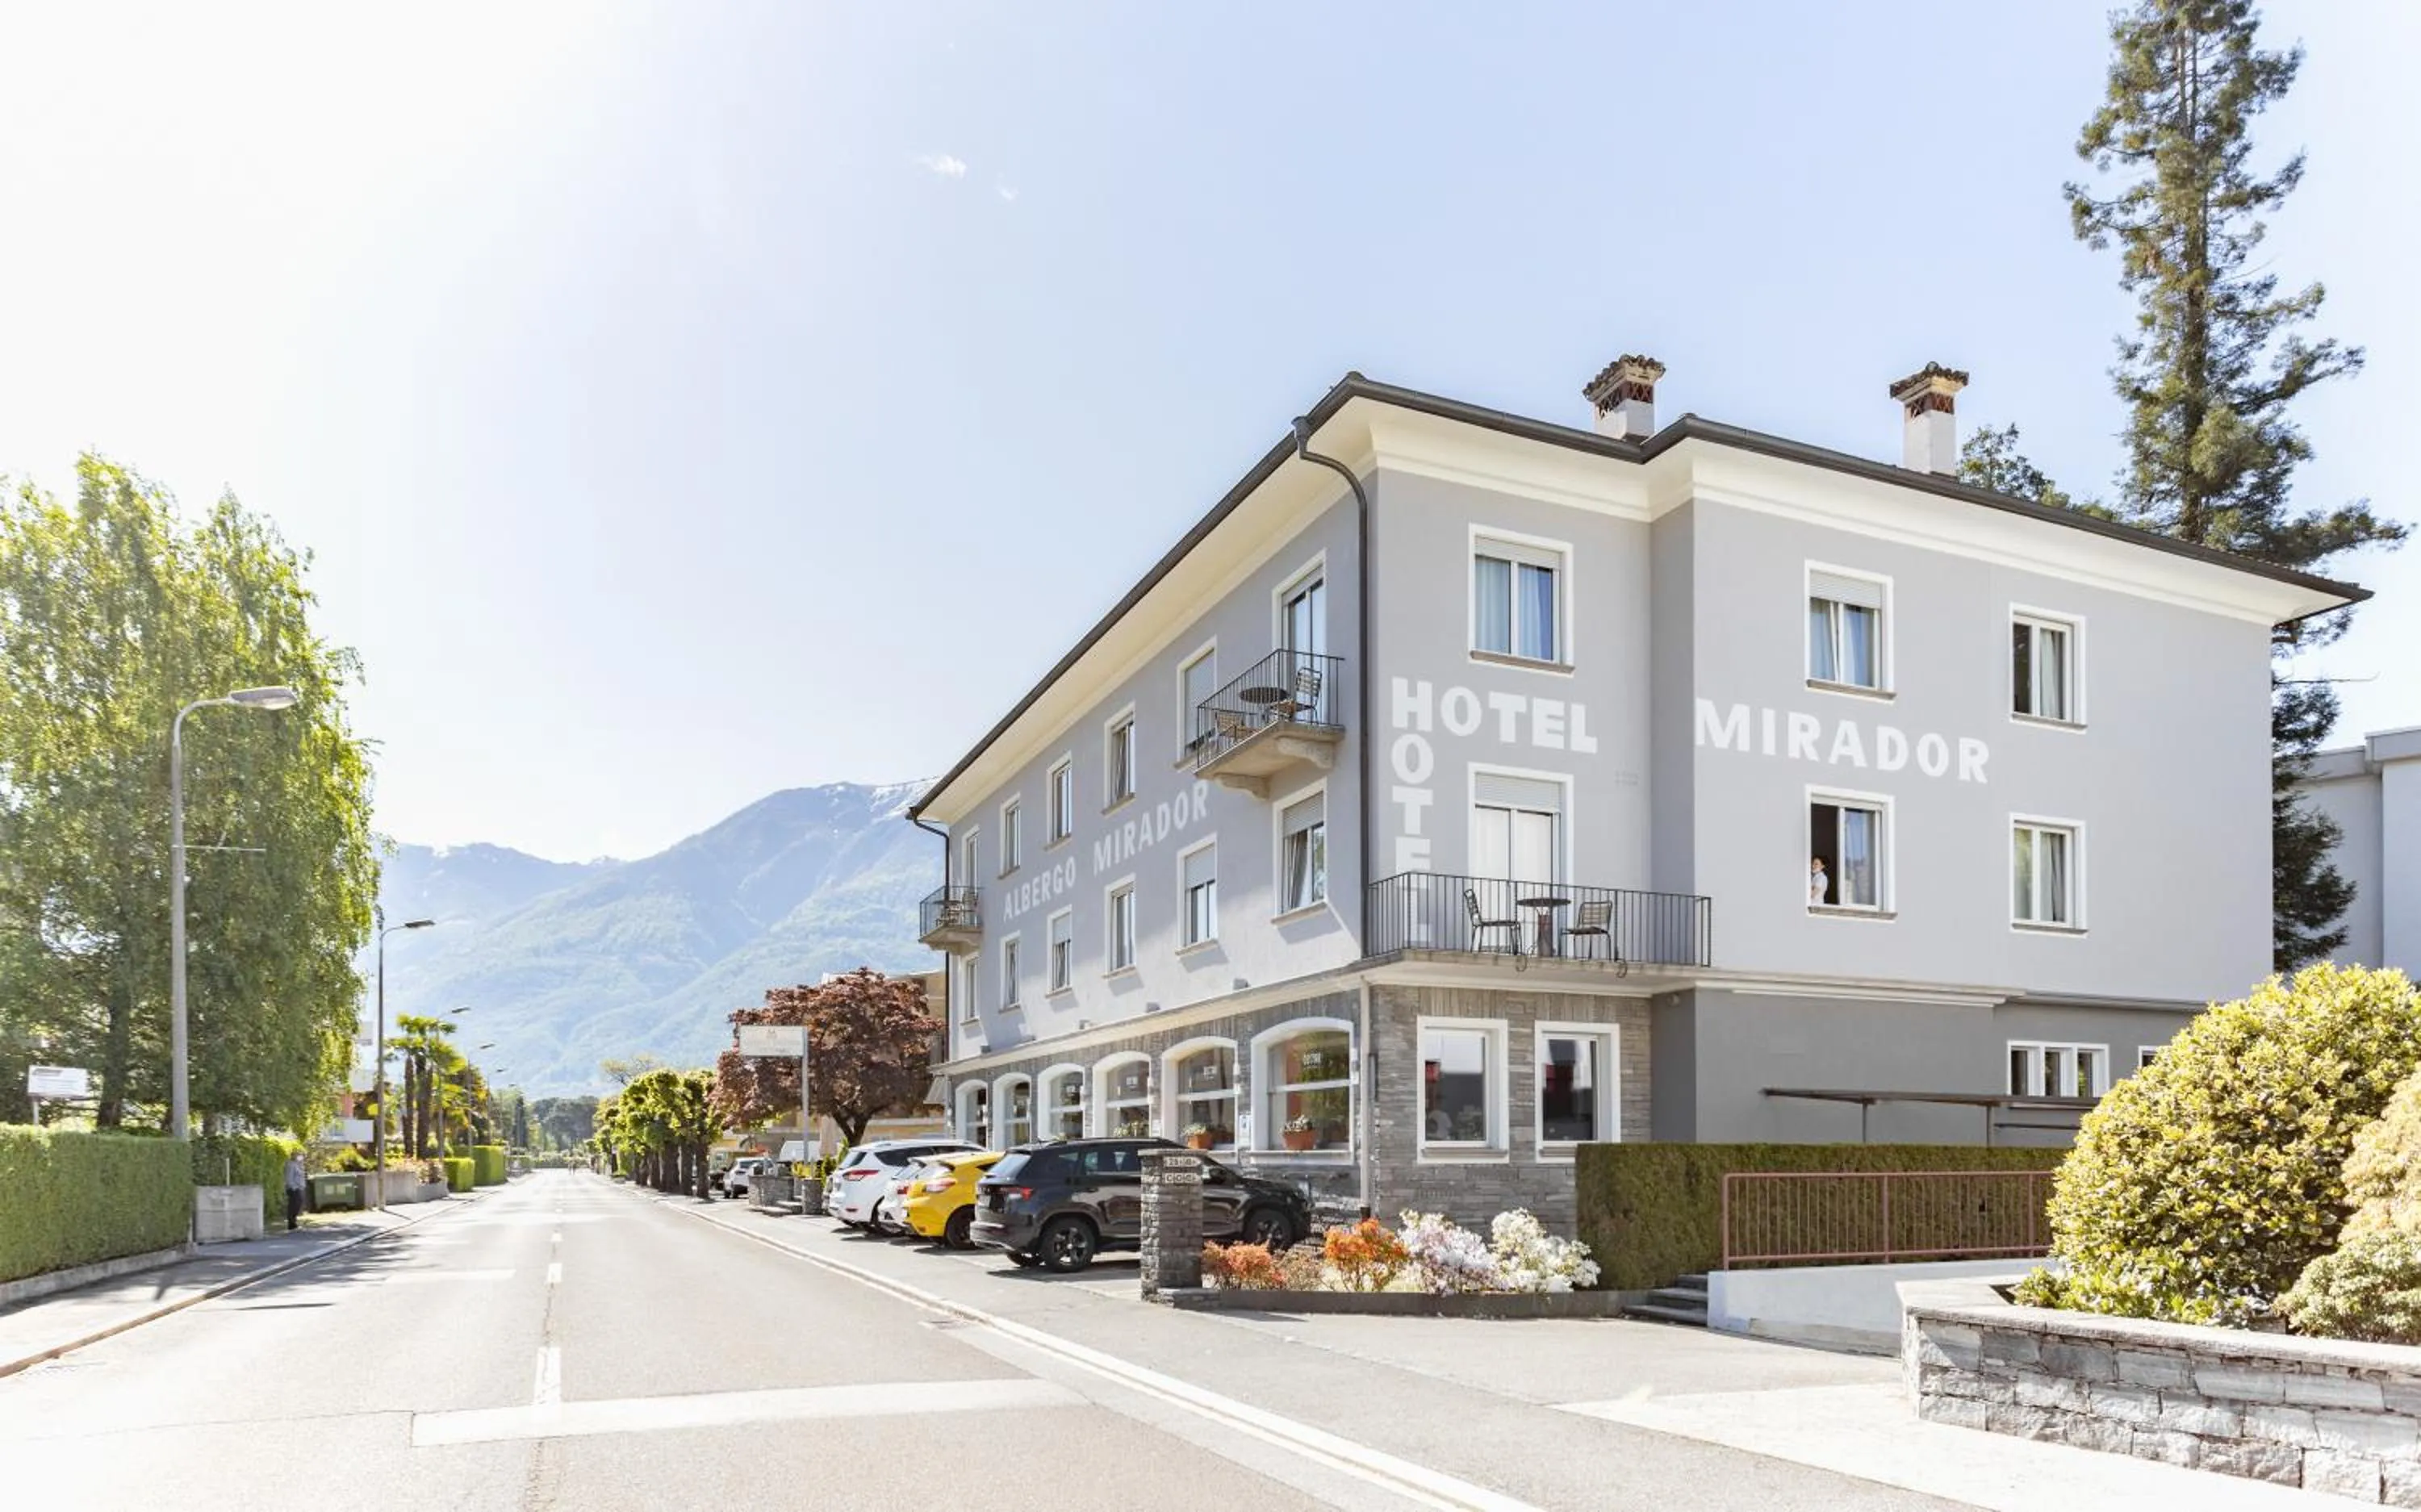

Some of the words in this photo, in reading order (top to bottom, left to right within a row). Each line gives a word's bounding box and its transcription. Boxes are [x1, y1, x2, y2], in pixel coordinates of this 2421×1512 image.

[1392, 677, 1598, 754] HOTEL
[1695, 697, 1989, 783] MIRADOR
[1003, 856, 1077, 923] ALBERGO
[1093, 779, 1209, 877] MIRADOR
